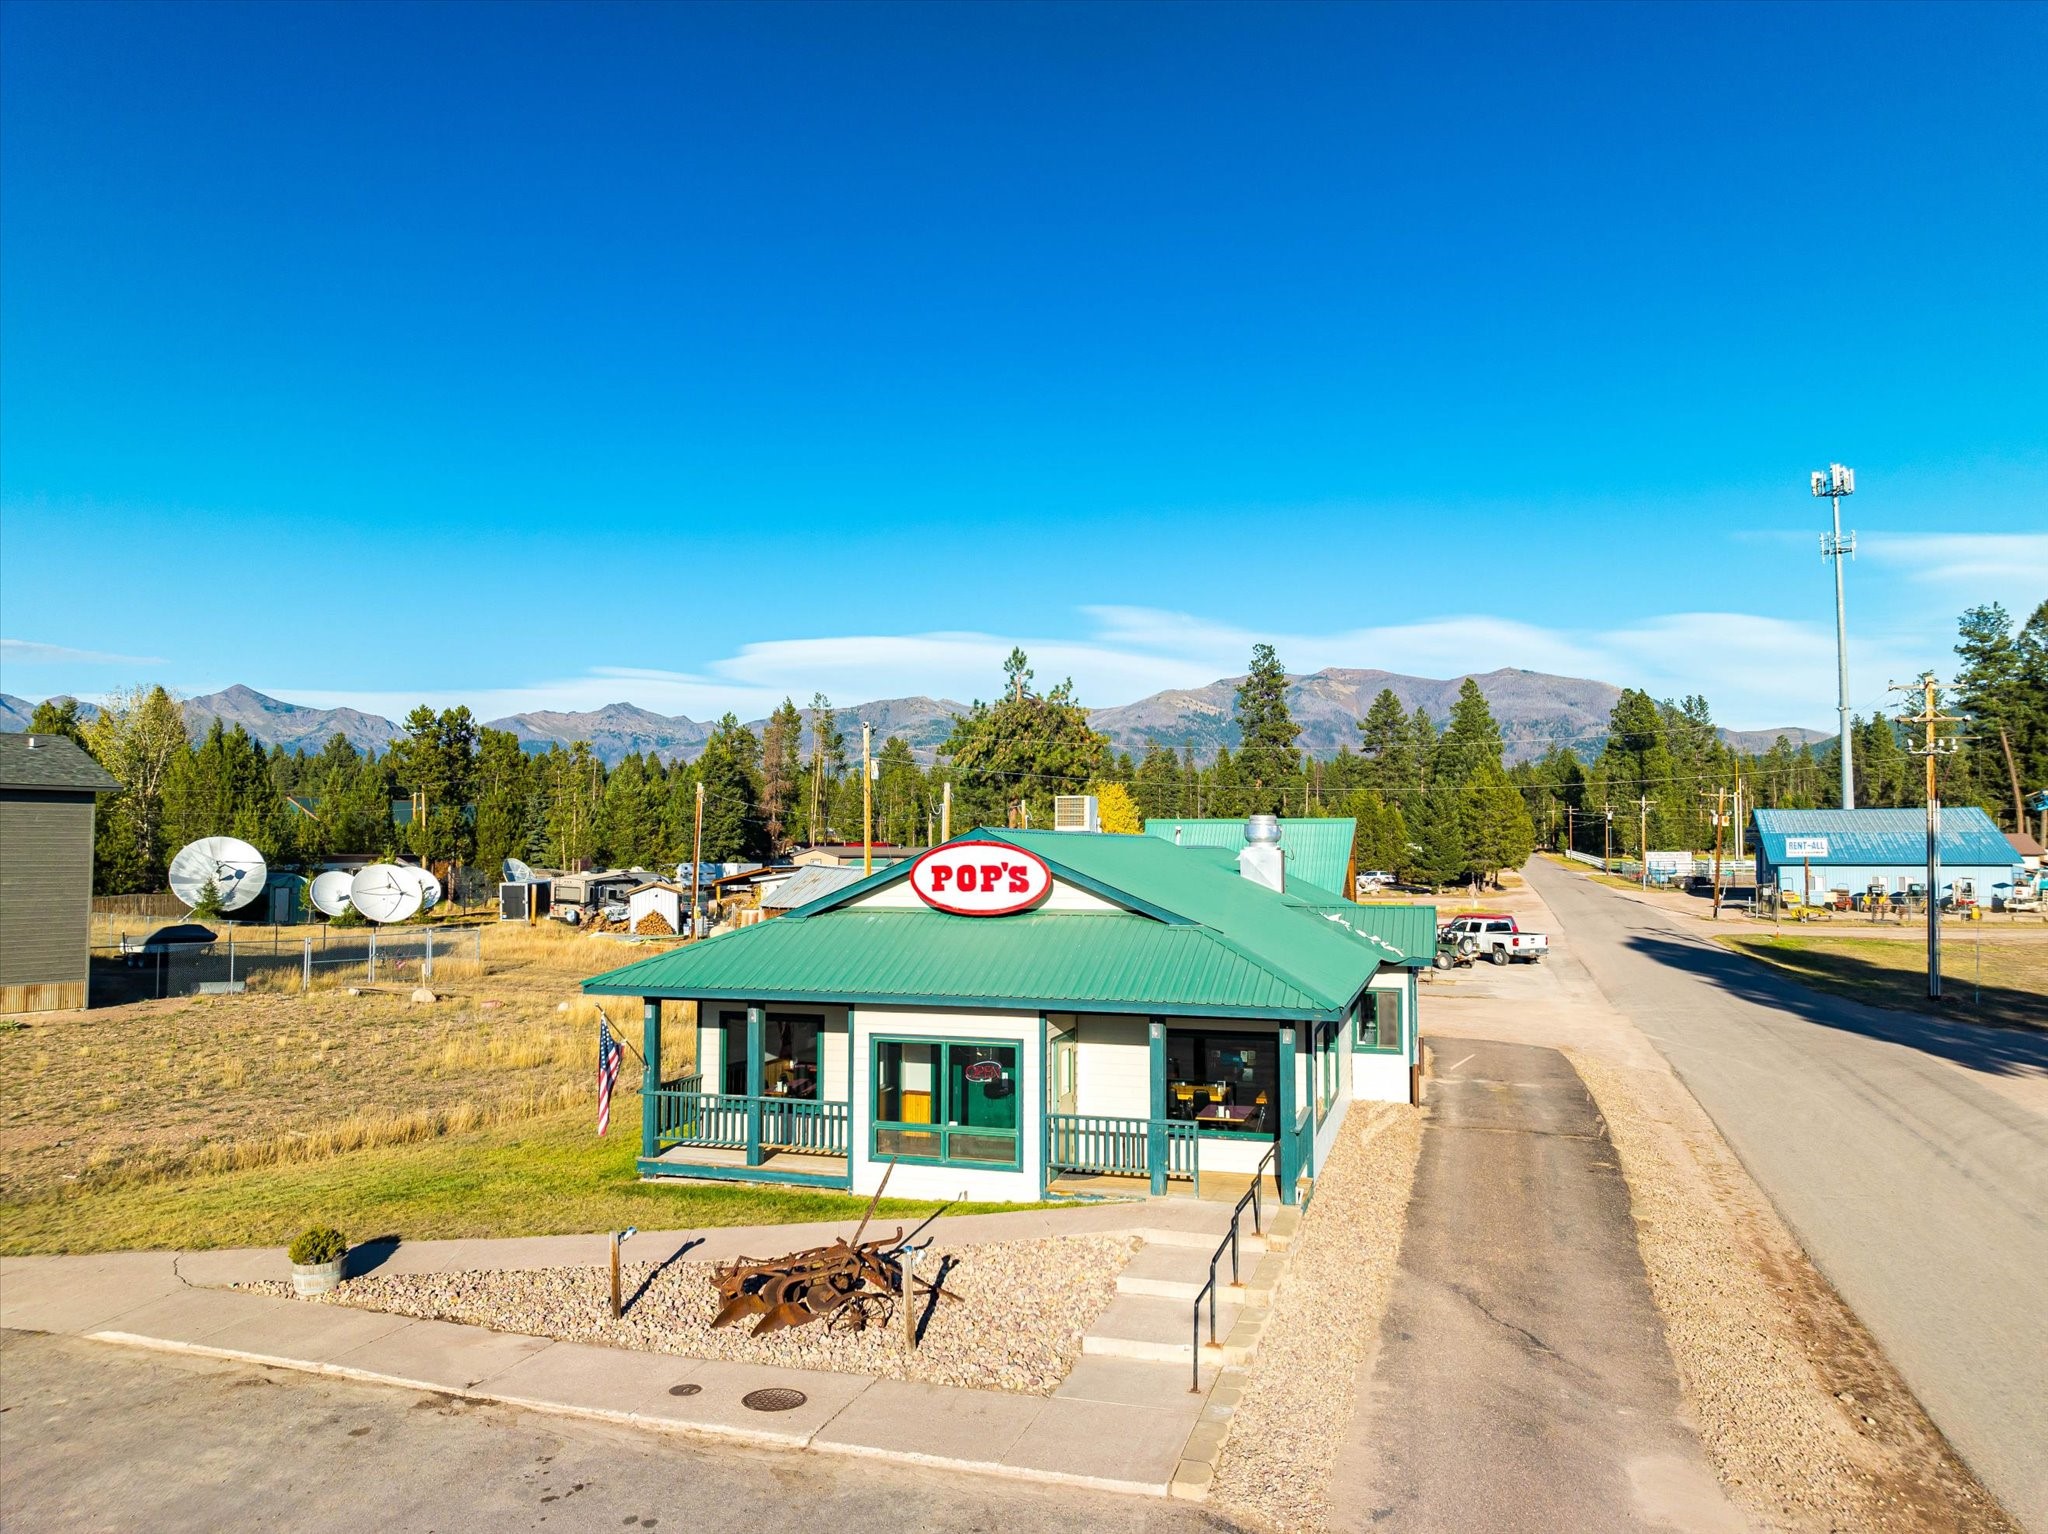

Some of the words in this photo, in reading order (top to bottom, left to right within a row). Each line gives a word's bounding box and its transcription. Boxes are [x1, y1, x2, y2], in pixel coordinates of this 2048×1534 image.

[1788, 841, 1825, 850] RENT-ALL
[931, 862, 1030, 893] POP'S
[965, 1065, 1001, 1079] OPEN
